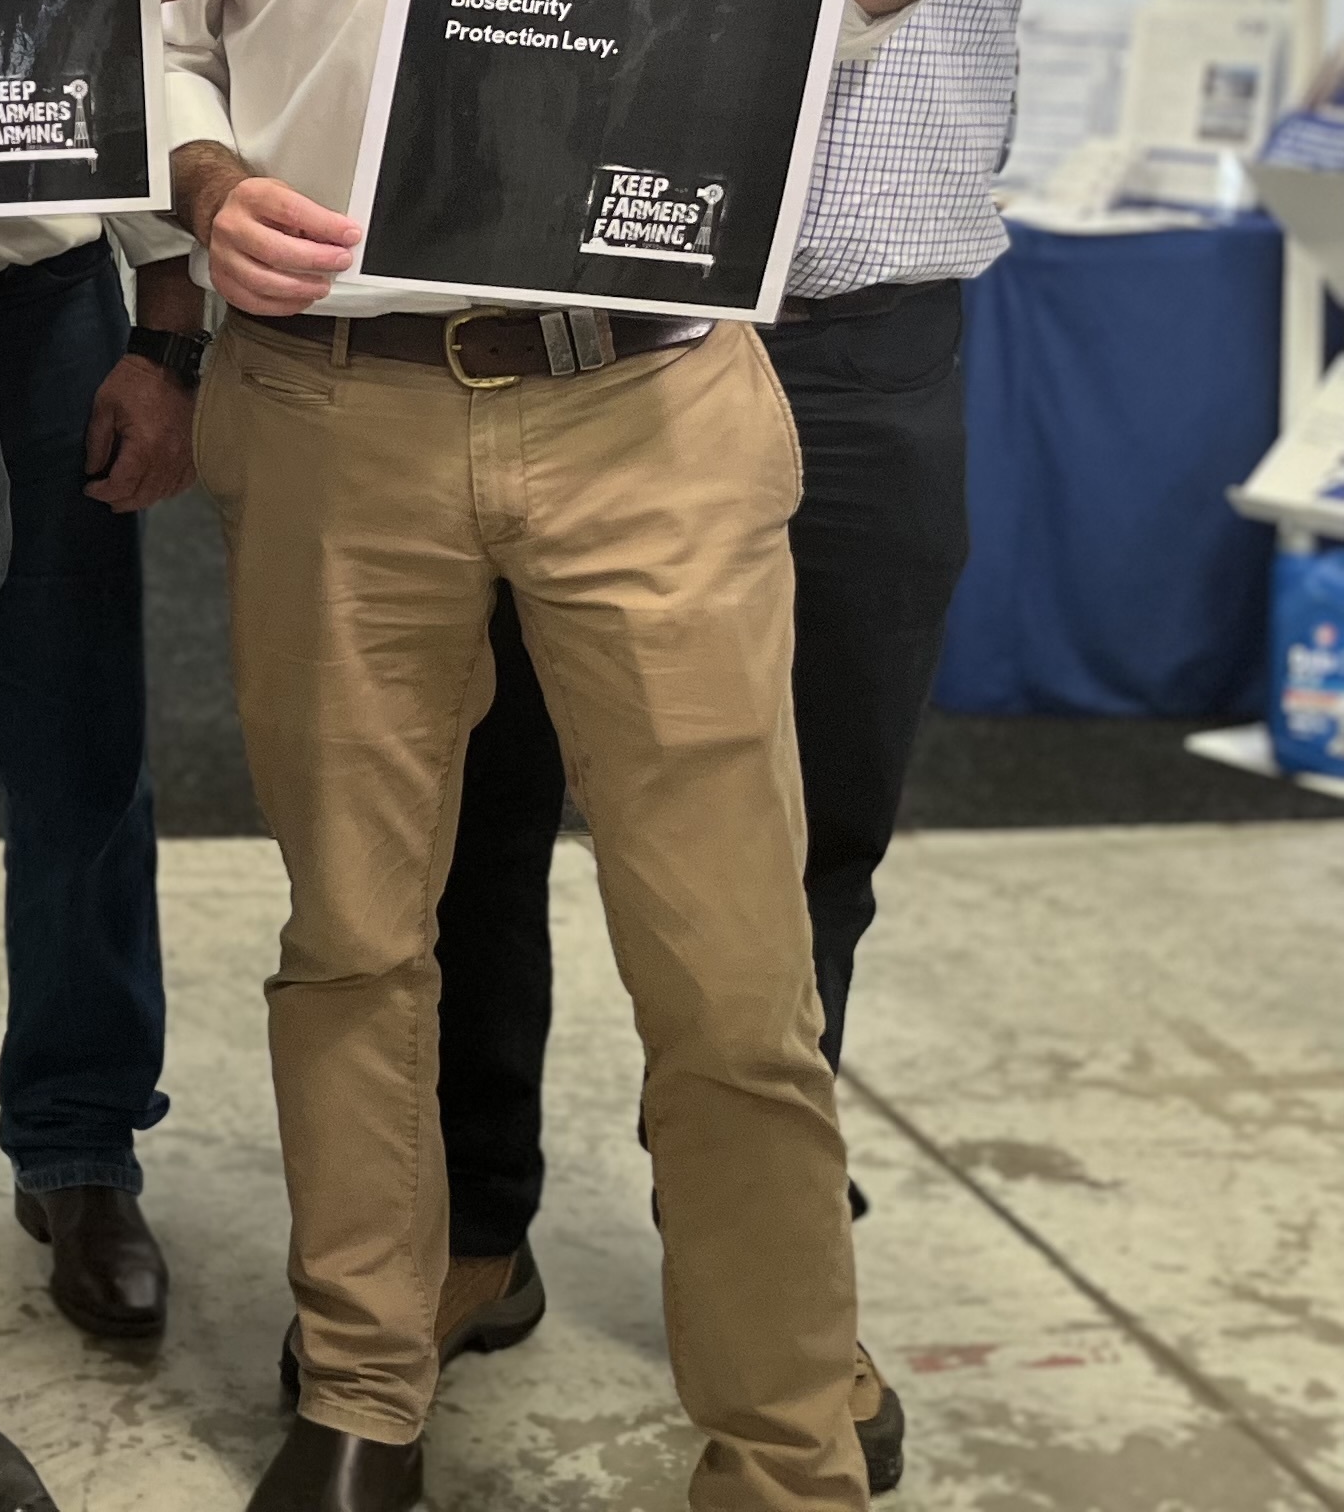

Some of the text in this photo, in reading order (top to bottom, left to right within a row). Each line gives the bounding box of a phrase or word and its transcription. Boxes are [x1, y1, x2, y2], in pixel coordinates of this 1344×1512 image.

[444, 19, 619, 59] Protection Levy.
[610, 174, 670, 199] KEEP
[601, 196, 700, 224] FARMERS
